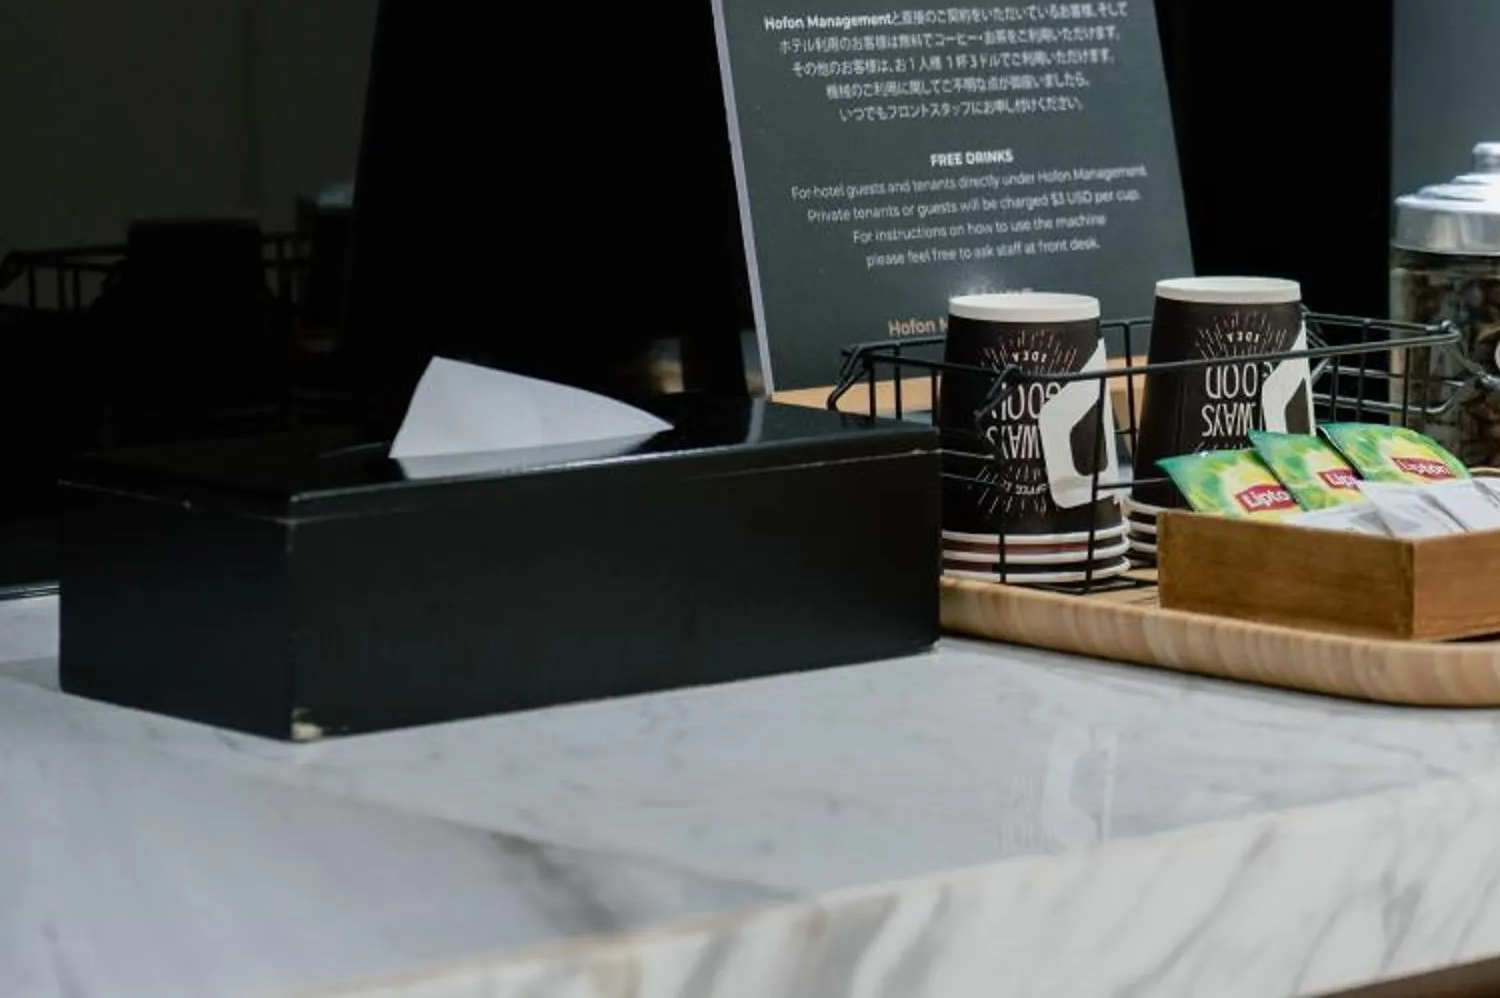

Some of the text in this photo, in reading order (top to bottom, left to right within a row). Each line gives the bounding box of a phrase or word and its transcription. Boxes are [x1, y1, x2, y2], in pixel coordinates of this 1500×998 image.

[765, 15, 804, 31] Hofon
[930, 148, 1014, 167] FREE DRINKS
[791, 186, 811, 200] For
[813, 182, 845, 199] hotel
[846, 182, 886, 199] guests
[887, 181, 910, 193] and
[912, 178, 956, 193] tenants
[957, 176, 999, 190] directly
[1002, 172, 1035, 187] under
[1037, 169, 1072, 183] Hofon
[807, 208, 850, 223] Private
[853, 205, 900, 220] tenants
[902, 206, 915, 217] or
[917, 202, 958, 218] guests
[960, 199, 979, 212] will
[982, 198, 997, 211] be
[1000, 194, 1048, 211] charged
[1066, 190, 1092, 204] USD
[1095, 190, 1113, 205] per
[853, 214, 1106, 244] For instructions on how to use the machine
[866, 253, 905, 270] please
[907, 249, 931, 264] feel
[931, 247, 957, 262] free
[959, 247, 972, 261] to
[974, 244, 994, 258] ask
[996, 240, 1021, 257] staff
[1024, 242, 1036, 254] at
[1038, 239, 1068, 254] front
[888, 319, 936, 337] Hofon
[1226, 330, 1260, 343] IDEA
[1012, 351, 1047, 363] IDEA
[1201, 401, 1262, 437] WAYS
[986, 424, 1042, 460] WAYS
[1242, 486, 1290, 508] Lipto
